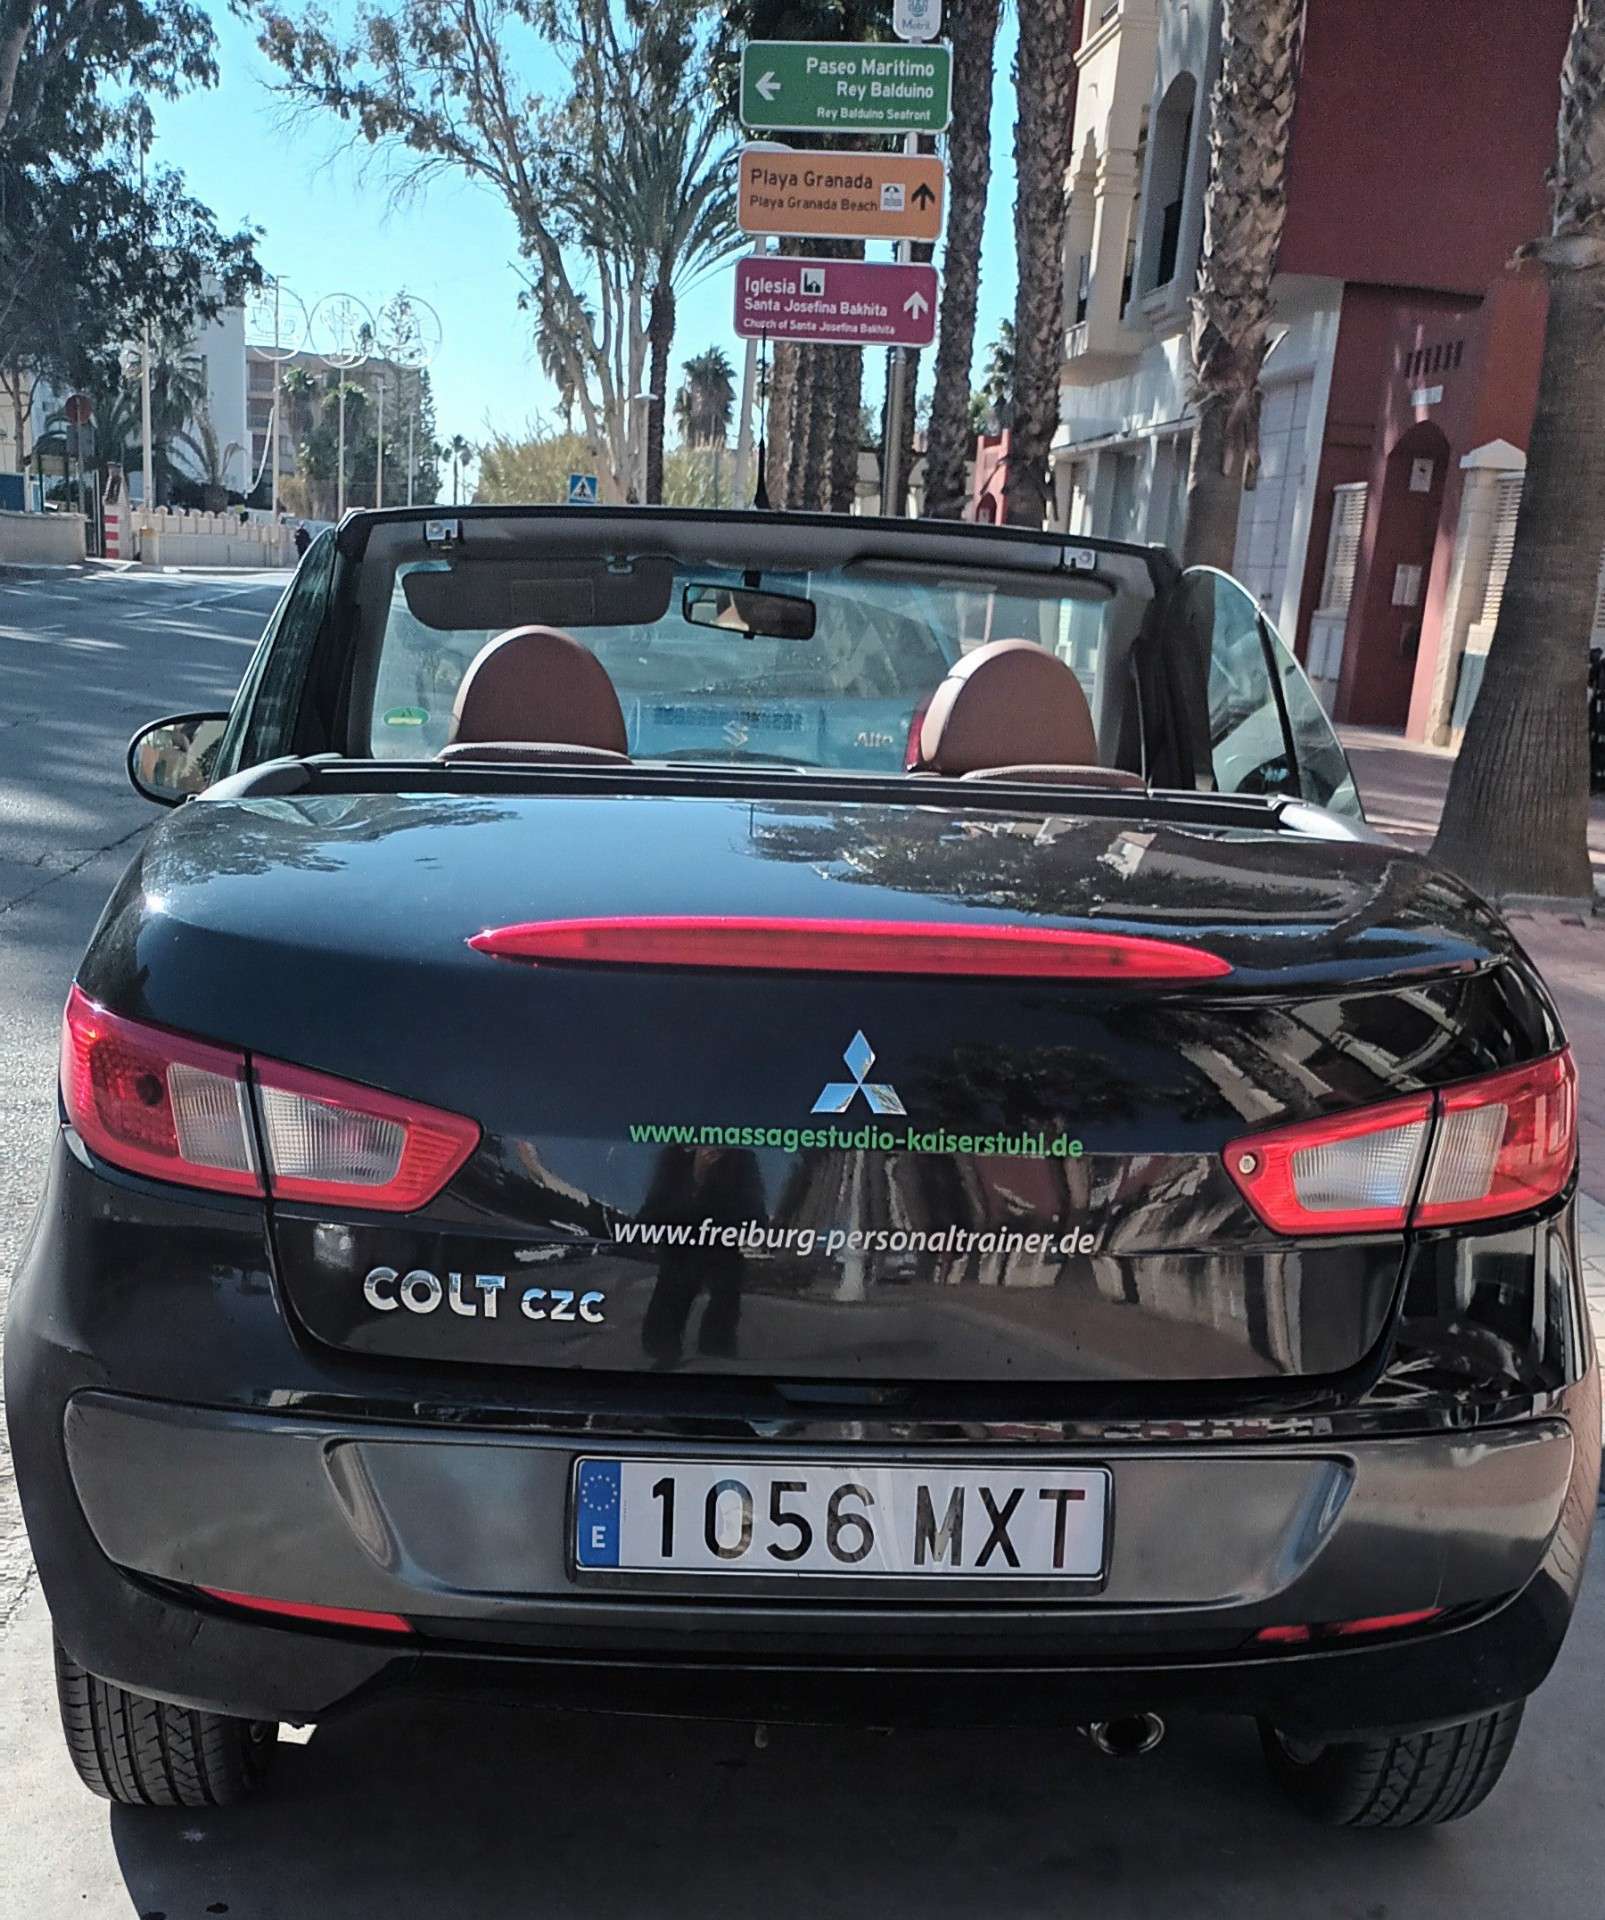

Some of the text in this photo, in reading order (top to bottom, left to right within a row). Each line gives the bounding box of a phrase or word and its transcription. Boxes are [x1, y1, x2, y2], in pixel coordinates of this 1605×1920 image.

[806, 57, 856, 75] Paseo
[836, 81, 934, 101] Rey Balduino
[817, 107, 931, 121] Rey Balduino Seafront
[751, 168, 873, 191] Playa Granada
[750, 194, 878, 212] Playa Granada Beach
[745, 276, 796, 297] Iglesia
[744, 298, 888, 317] Santa Josefina Bakhita
[743, 319, 896, 335] Church of Santa Josefina Bakhita
[854, 731, 893, 748] Alto
[629, 1123, 1084, 1158] www.massagestudio-kaiserstuhl.de
[614, 1217, 1096, 1256] www.freiburg-personaltrainer.de
[363, 1266, 507, 1318] COLT
[591, 1477, 1086, 1569] E 1056 MXT
